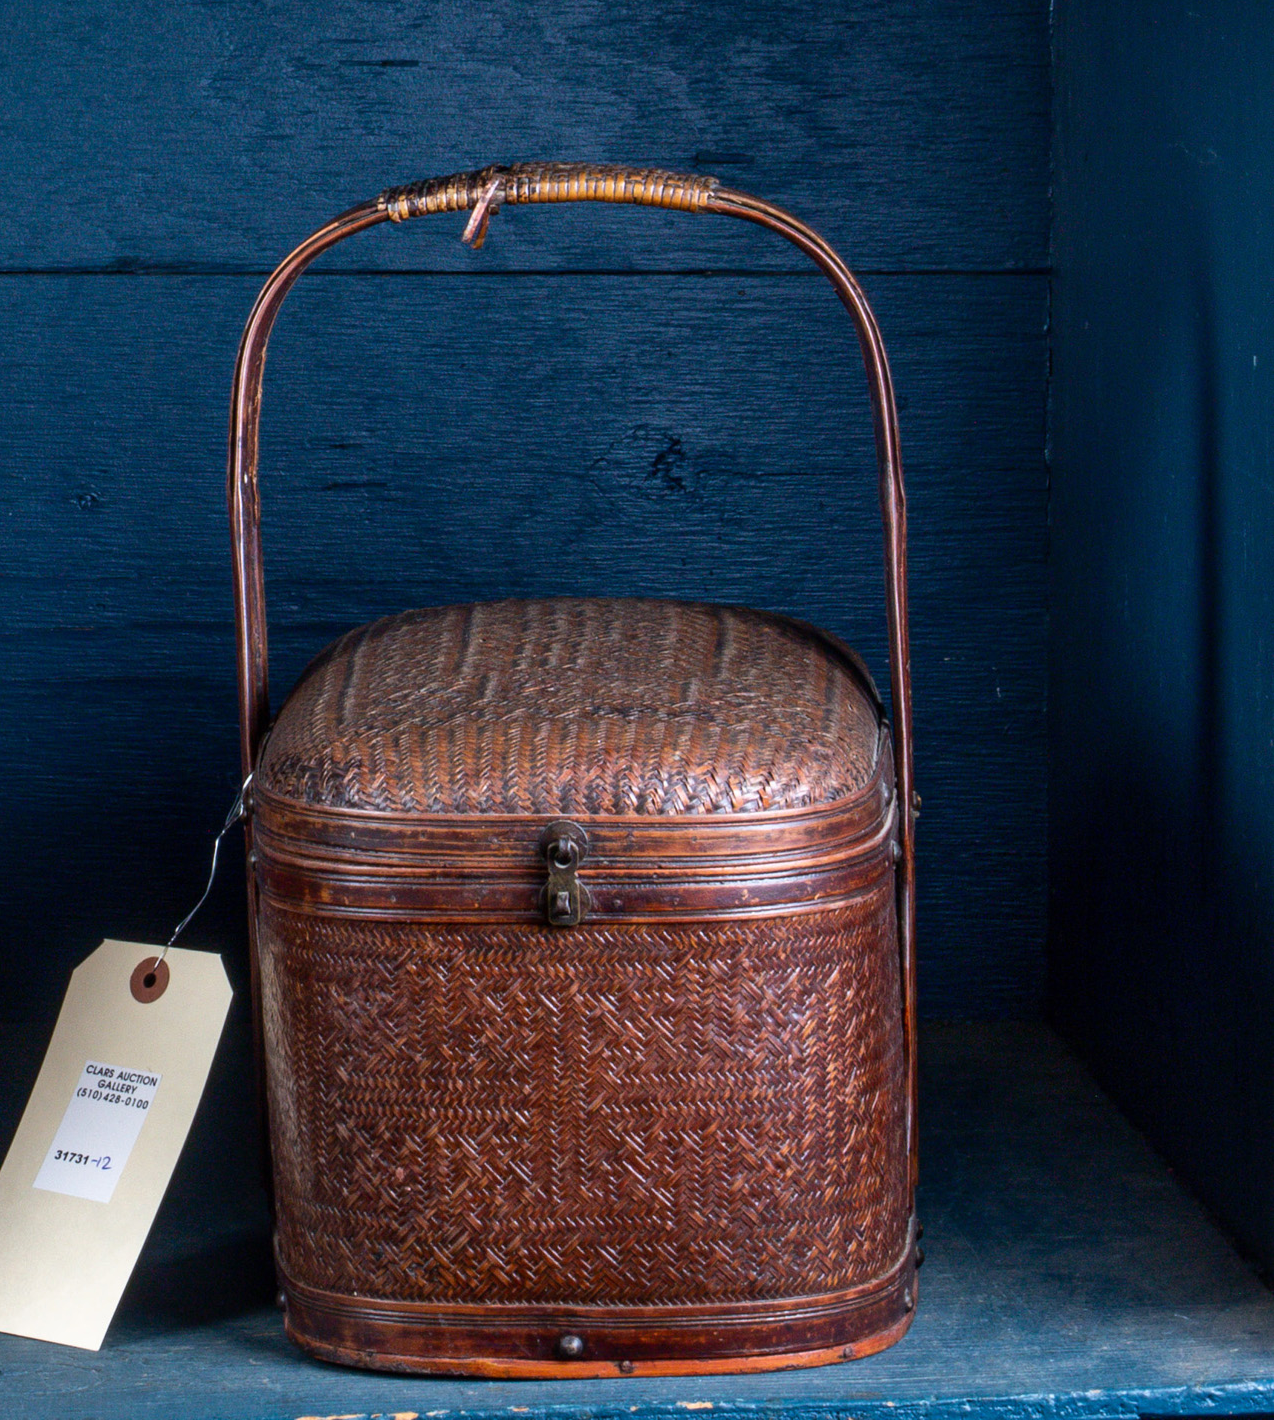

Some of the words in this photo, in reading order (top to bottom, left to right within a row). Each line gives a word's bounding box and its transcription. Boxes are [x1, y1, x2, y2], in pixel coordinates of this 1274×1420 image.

[85, 1064, 115, 1078] CLARS
[116, 1071, 158, 1087] AUCTION
[97, 1079, 137, 1095] GALLERY
